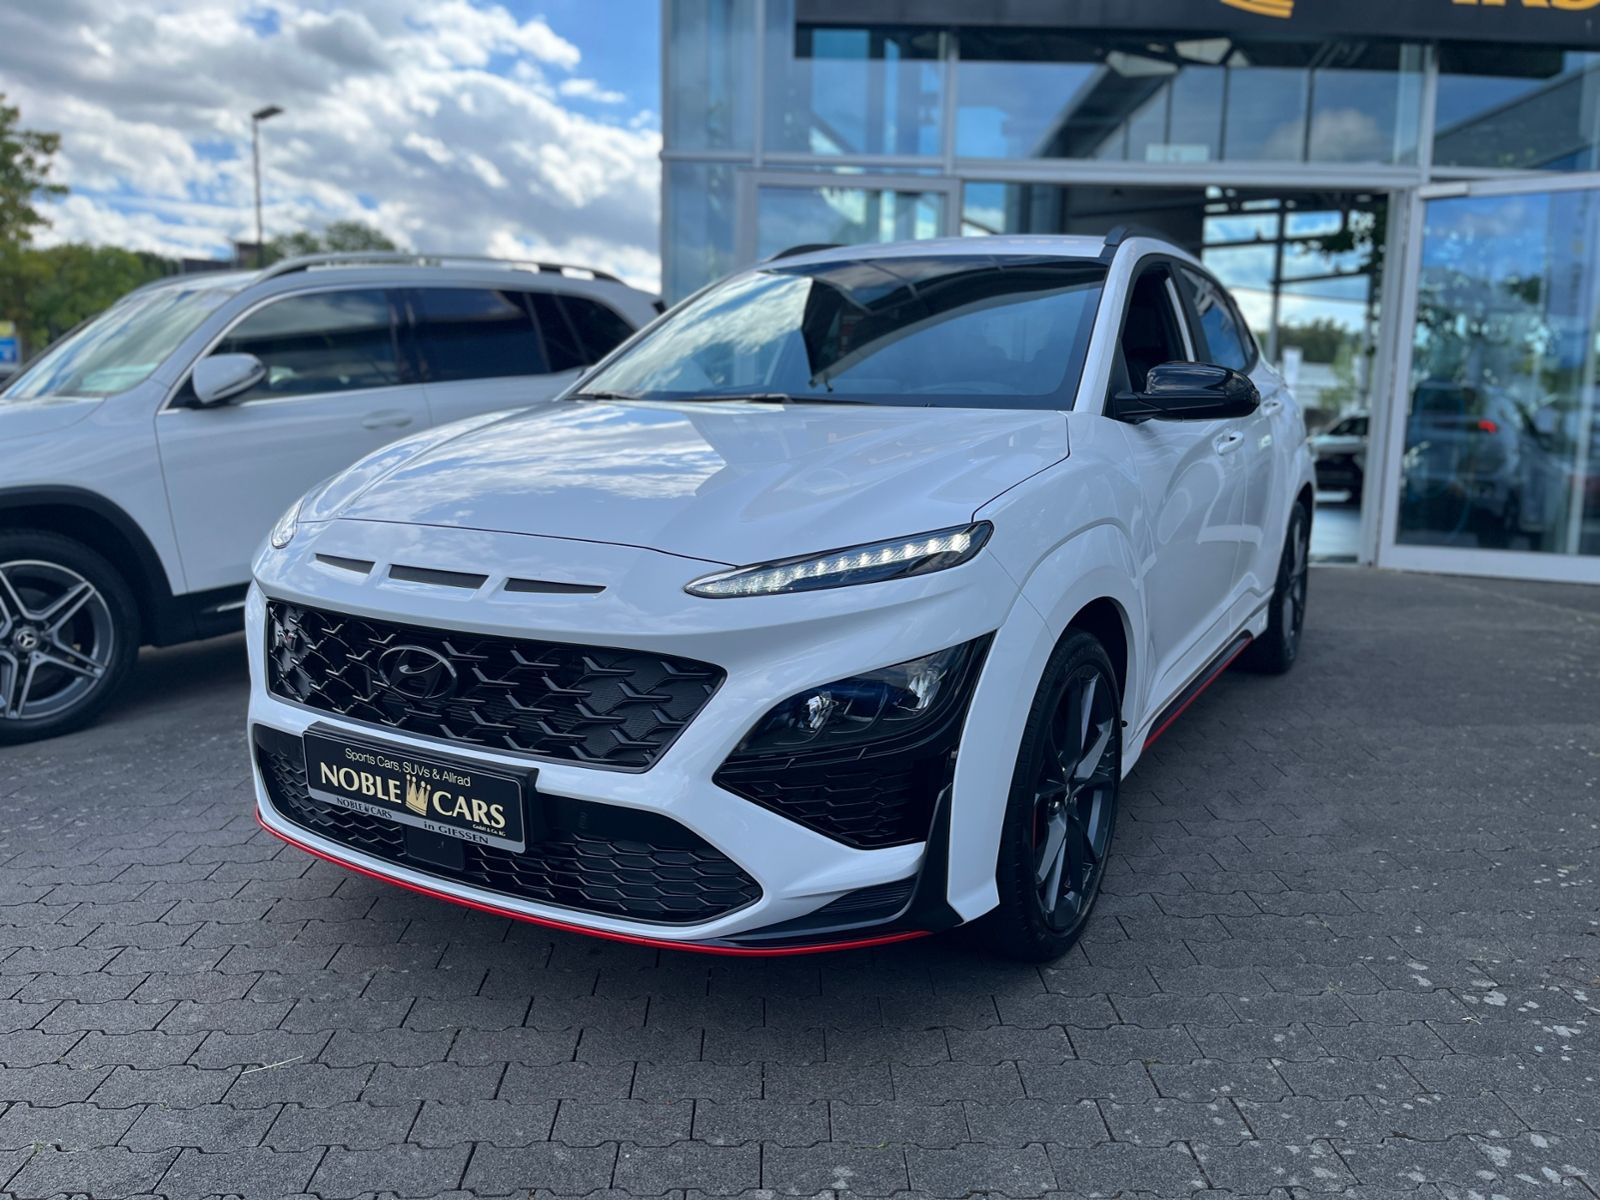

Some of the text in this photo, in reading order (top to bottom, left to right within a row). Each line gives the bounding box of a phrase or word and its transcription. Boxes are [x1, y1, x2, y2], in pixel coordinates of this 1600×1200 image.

[345, 748, 376, 765] Sports
[403, 761, 430, 778] SUVs
[432, 769, 440, 780] &
[442, 771, 471, 787] Allrad
[320, 762, 506, 829] NOBLE CARS
[336, 796, 393, 819] NOBLE CARS
[424, 821, 489, 844] in GIESSEN
